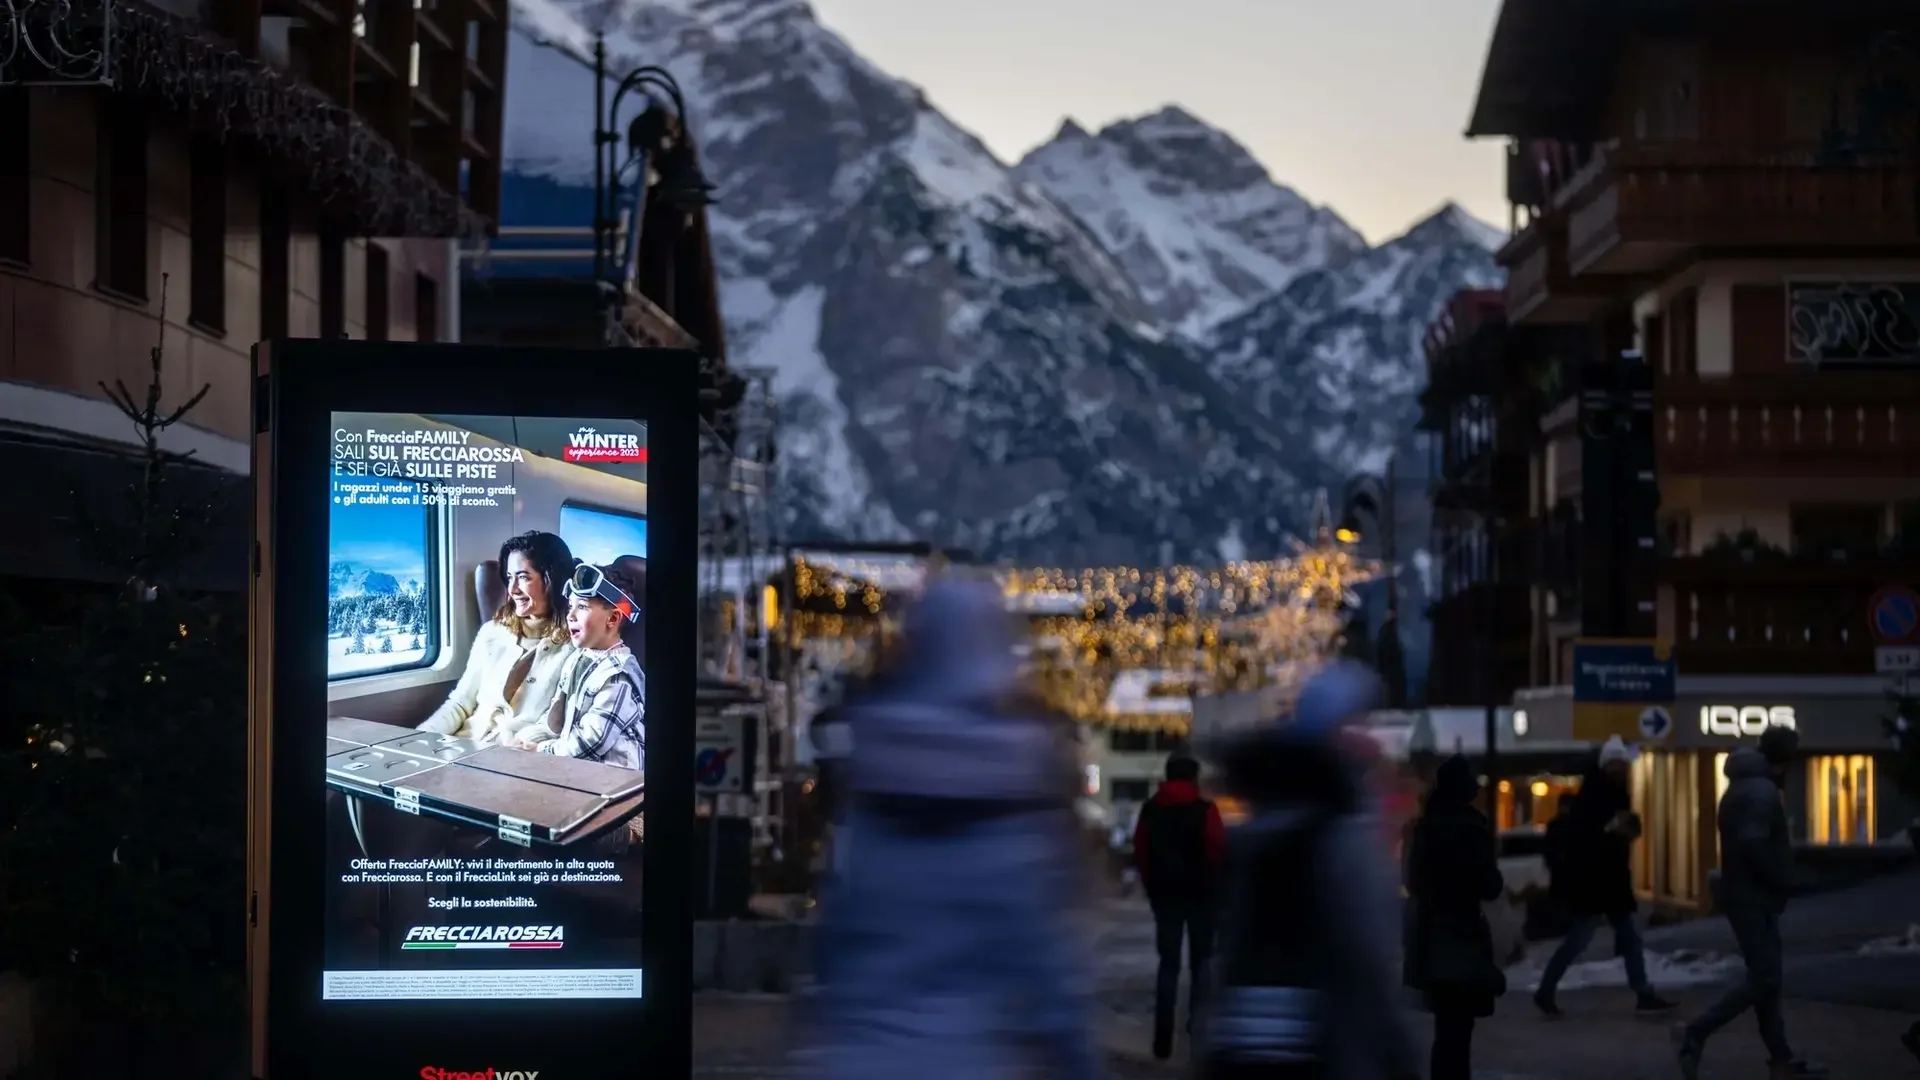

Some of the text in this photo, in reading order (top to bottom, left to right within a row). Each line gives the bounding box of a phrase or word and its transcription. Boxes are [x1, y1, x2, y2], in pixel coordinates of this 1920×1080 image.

[334, 428, 471, 445] Con FrecciaFAMILY
[568, 433, 639, 449] WINTER
[334, 444, 524, 463] SALI SUL FRECCIAROSSA
[568, 448, 640, 461] experience 2023
[335, 460, 497, 479] E SEI GIÀ SULLE PISTE
[333, 481, 517, 497] I ragazzi under 15 viaggiano gratis
[333, 493, 499, 507] e gli adulti con il 50% di sconto.
[1700, 705, 1796, 738] IQOS
[350, 858, 615, 871] Offerta FrecciaFAMILY: vivi il divertimento in alta quota
[341, 871, 624, 884] con Frecciarossa. E con il FrecciaLink sei già a destinazione.
[428, 896, 538, 910] Scegli la sostenibilità.
[405, 926, 564, 941] FRECCIAROSSA
